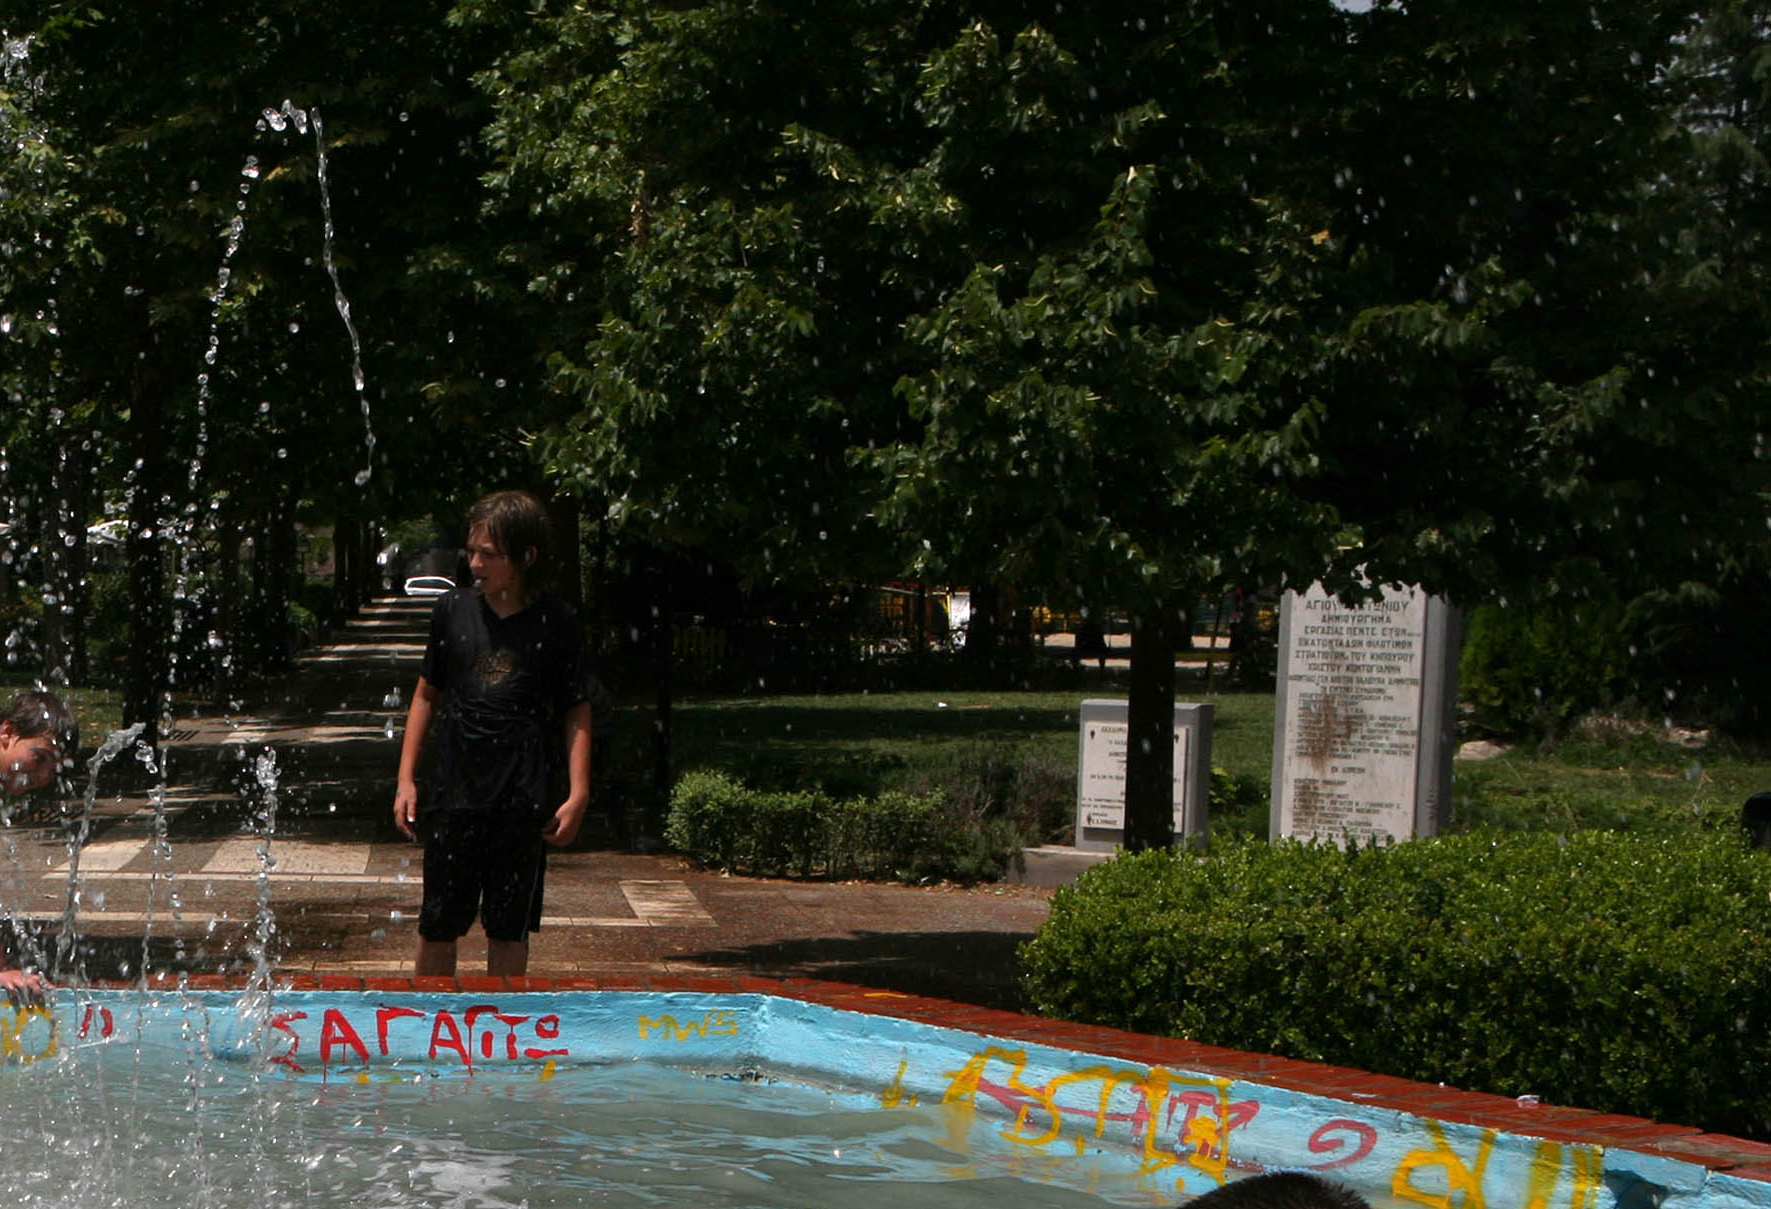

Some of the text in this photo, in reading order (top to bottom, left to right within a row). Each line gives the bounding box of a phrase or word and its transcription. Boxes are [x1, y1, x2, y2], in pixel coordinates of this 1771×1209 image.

[1321, 615, 1391, 623] ΔΗΜΙΟΥΡΓΗΜΑ
[1304, 626, 1343, 635] ΕΡΓΑΣΙΑΣ
[1346, 627, 1377, 636] ΠΕΝΤΕ
